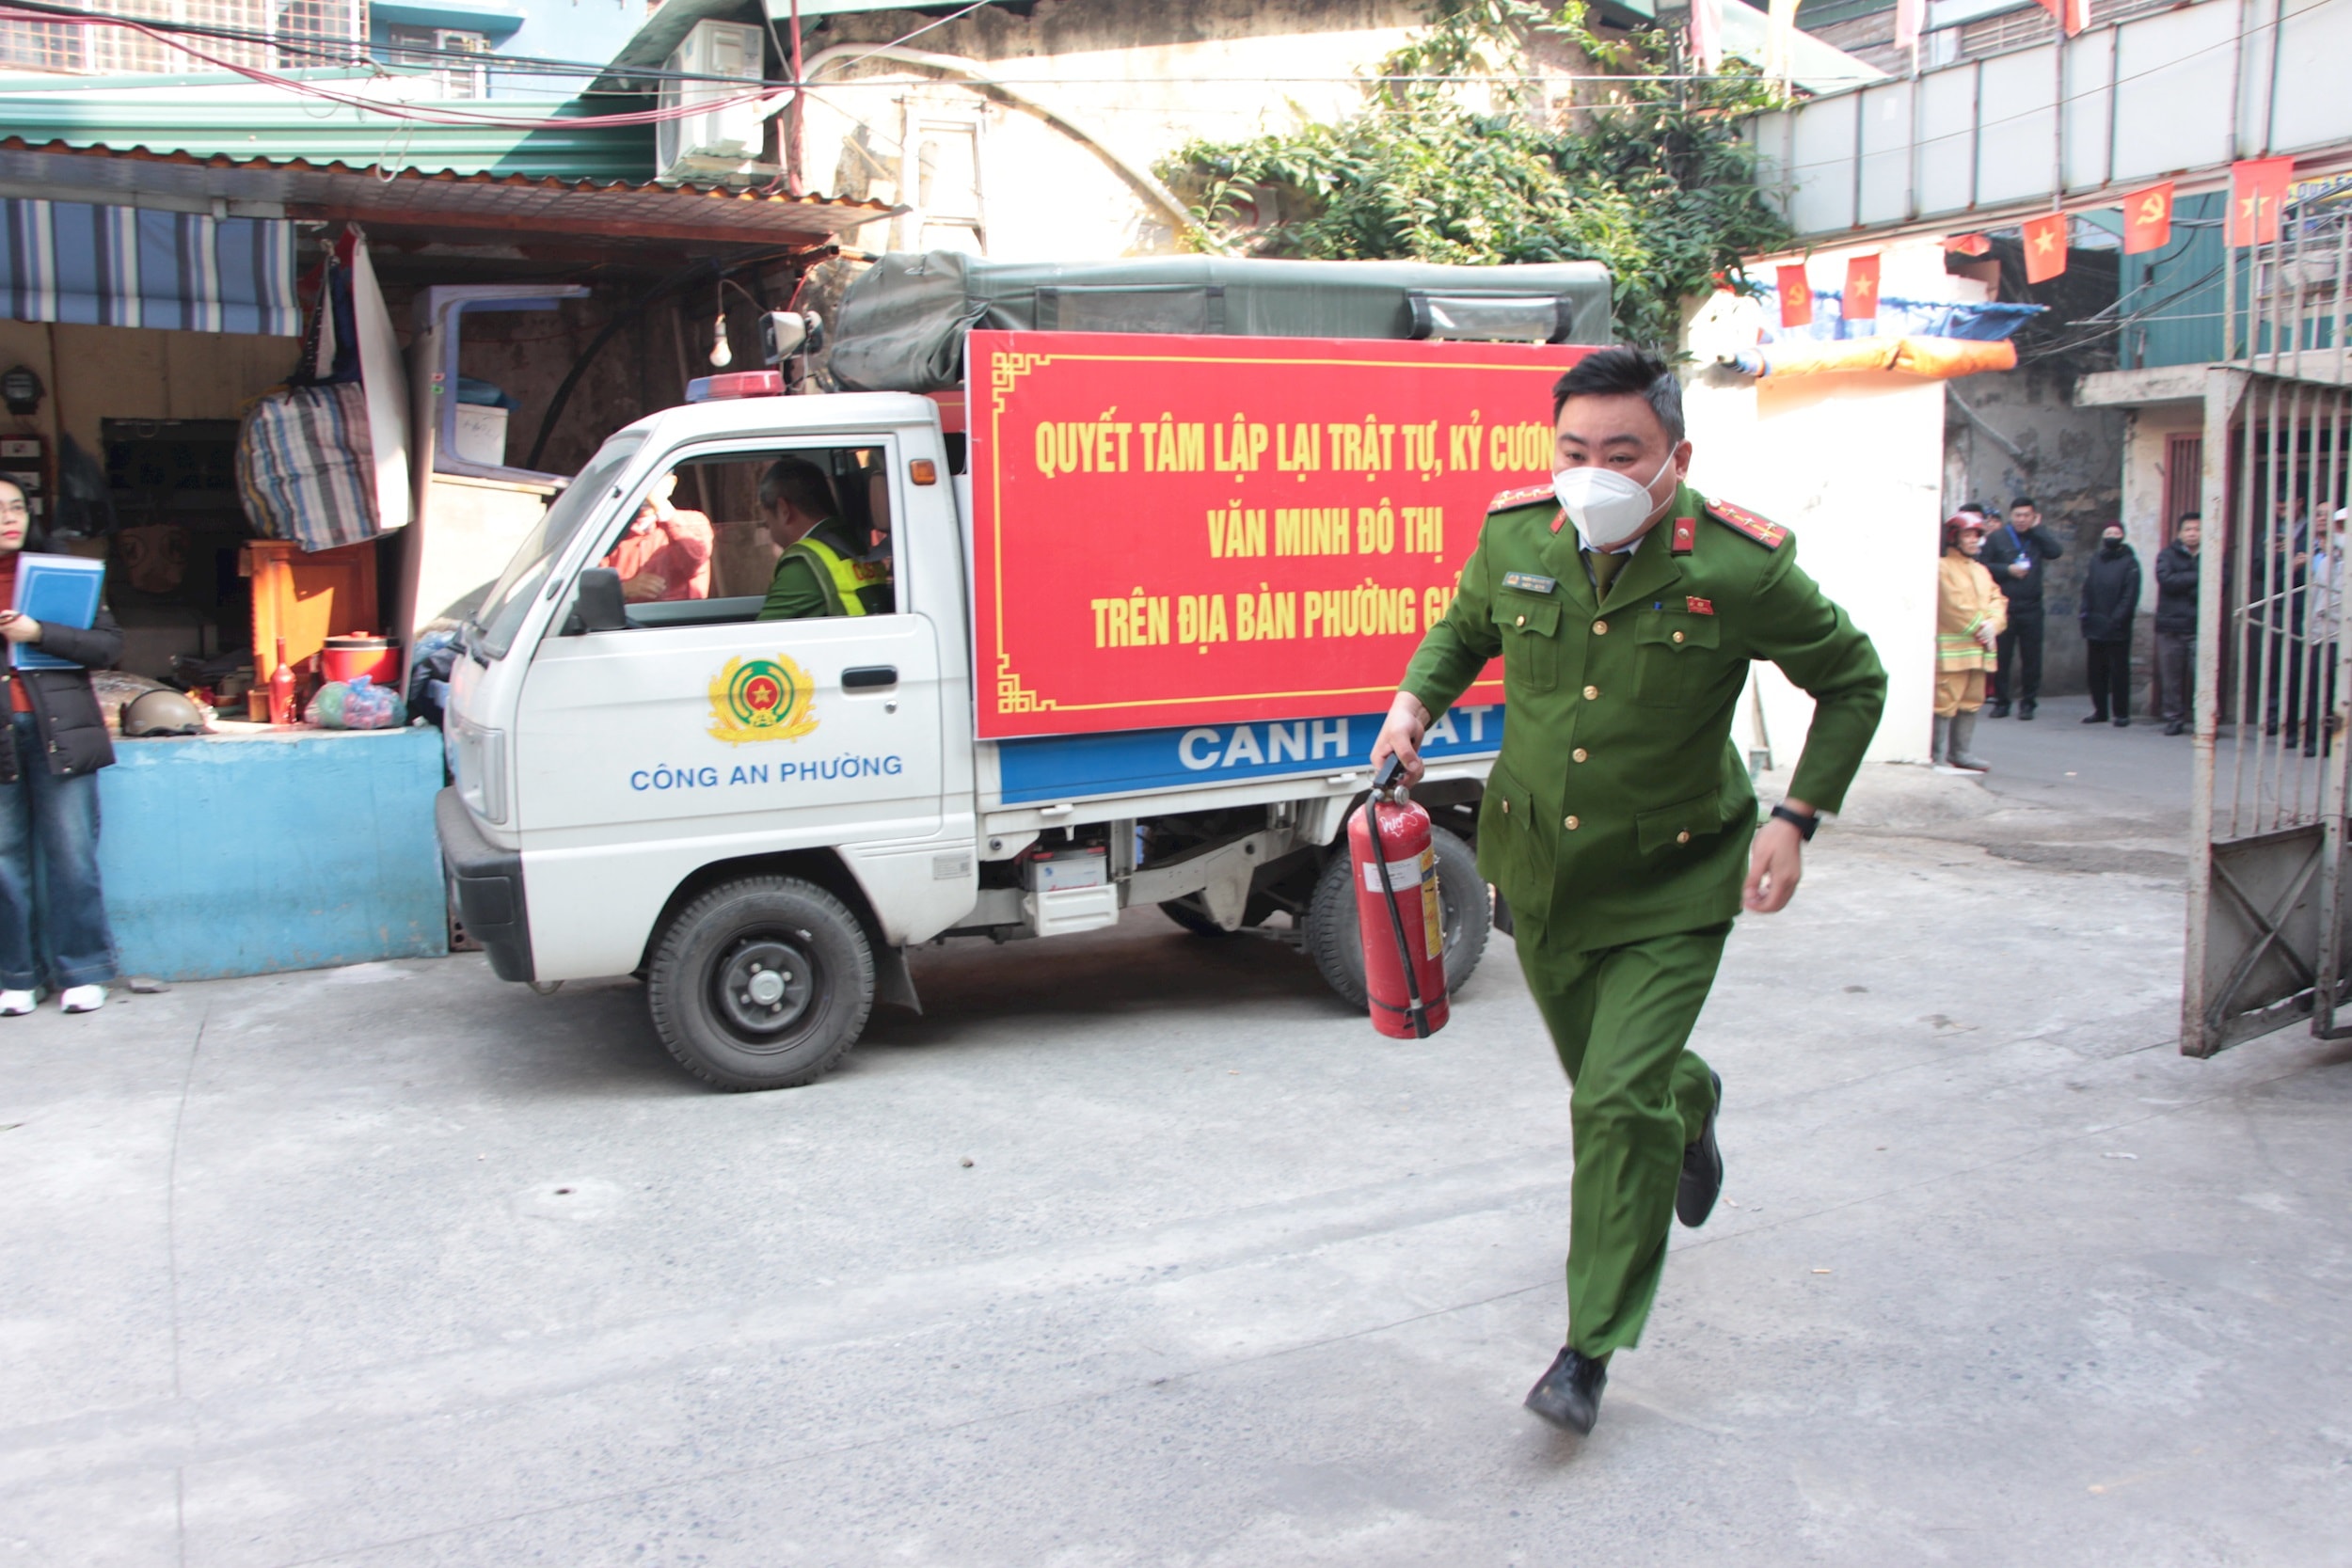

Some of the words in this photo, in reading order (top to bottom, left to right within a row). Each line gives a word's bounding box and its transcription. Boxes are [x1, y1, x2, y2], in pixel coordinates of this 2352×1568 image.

[1035, 405, 1133, 479] QUYẾT
[1139, 412, 1205, 472] TÂM
[1214, 412, 1268, 483] LẬP
[1277, 423, 1321, 483] LẠI
[1327, 413, 1395, 483] TRẬT
[1401, 420, 1442, 482] TỰ,
[1450, 409, 1484, 471] KỶ
[1489, 420, 1556, 472] CƯƠN
[1207, 498, 1266, 558] VĂN
[1275, 507, 1350, 557] MINH
[1357, 498, 1394, 555] ĐÔ
[1401, 506, 1443, 563] THỊ
[1090, 586, 1169, 648] TRÊN
[1177, 594, 1229, 655] ĐỊA
[1236, 582, 1295, 642] BÀN
[1304, 577, 1416, 639] PHƯỜNG
[1422, 705, 1494, 747] AT
[629, 763, 719, 791] CÔNG
[729, 764, 769, 785] AN
[780, 752, 903, 782] PHƯỜNG
